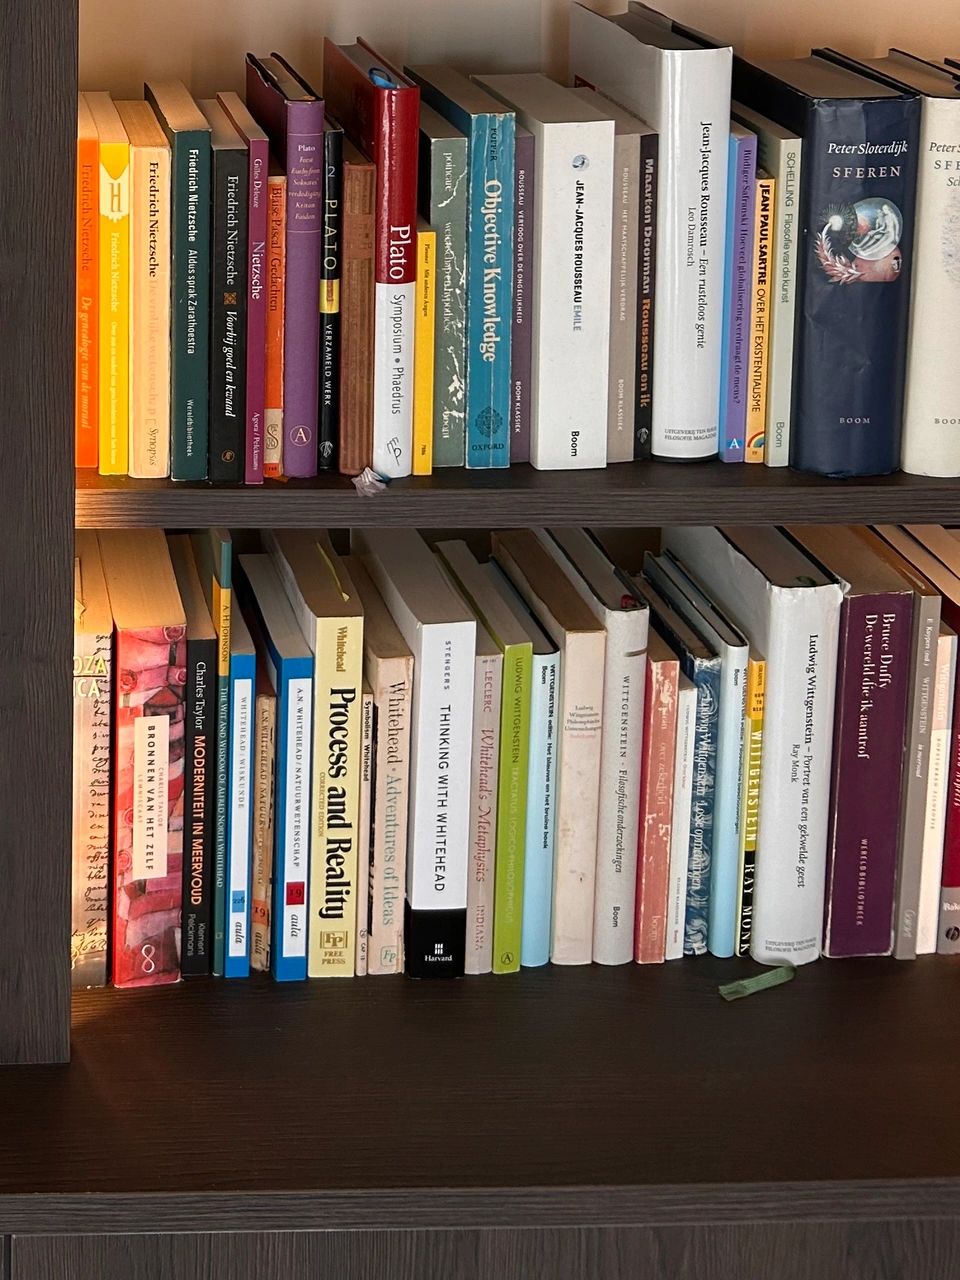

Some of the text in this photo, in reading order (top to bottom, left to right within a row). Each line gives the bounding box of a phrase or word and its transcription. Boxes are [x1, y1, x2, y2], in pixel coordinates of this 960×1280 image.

[828, 141, 908, 156] Peter Sloterdijk
[833, 166, 901, 178] SFEREN
[184, 148, 200, 355] Friedrich Nietzsche Aldus sprak Zarathoestra
[323, 166, 337, 270] 2 PLATO
[477, 178, 503, 363] Objective Knowledge
[571, 178, 585, 332] JEAN-JACQUES ROUSSEAU EMILE
[322, 322, 333, 406] VERZAMELD WERK
[191, 660, 207, 731] Charles Taylor
[144, 724, 156, 870] BRONNEN VAN HET ZELF
[189, 734, 206, 906] MODERNITEIT IN MEERVOUD
[317, 686, 357, 920] Process and Reality
[432, 703, 452, 892] THINKING WITH WHITEHEAD
[788, 742, 801, 784] Ray Monk
[425, 954, 452, 962] Harvard
